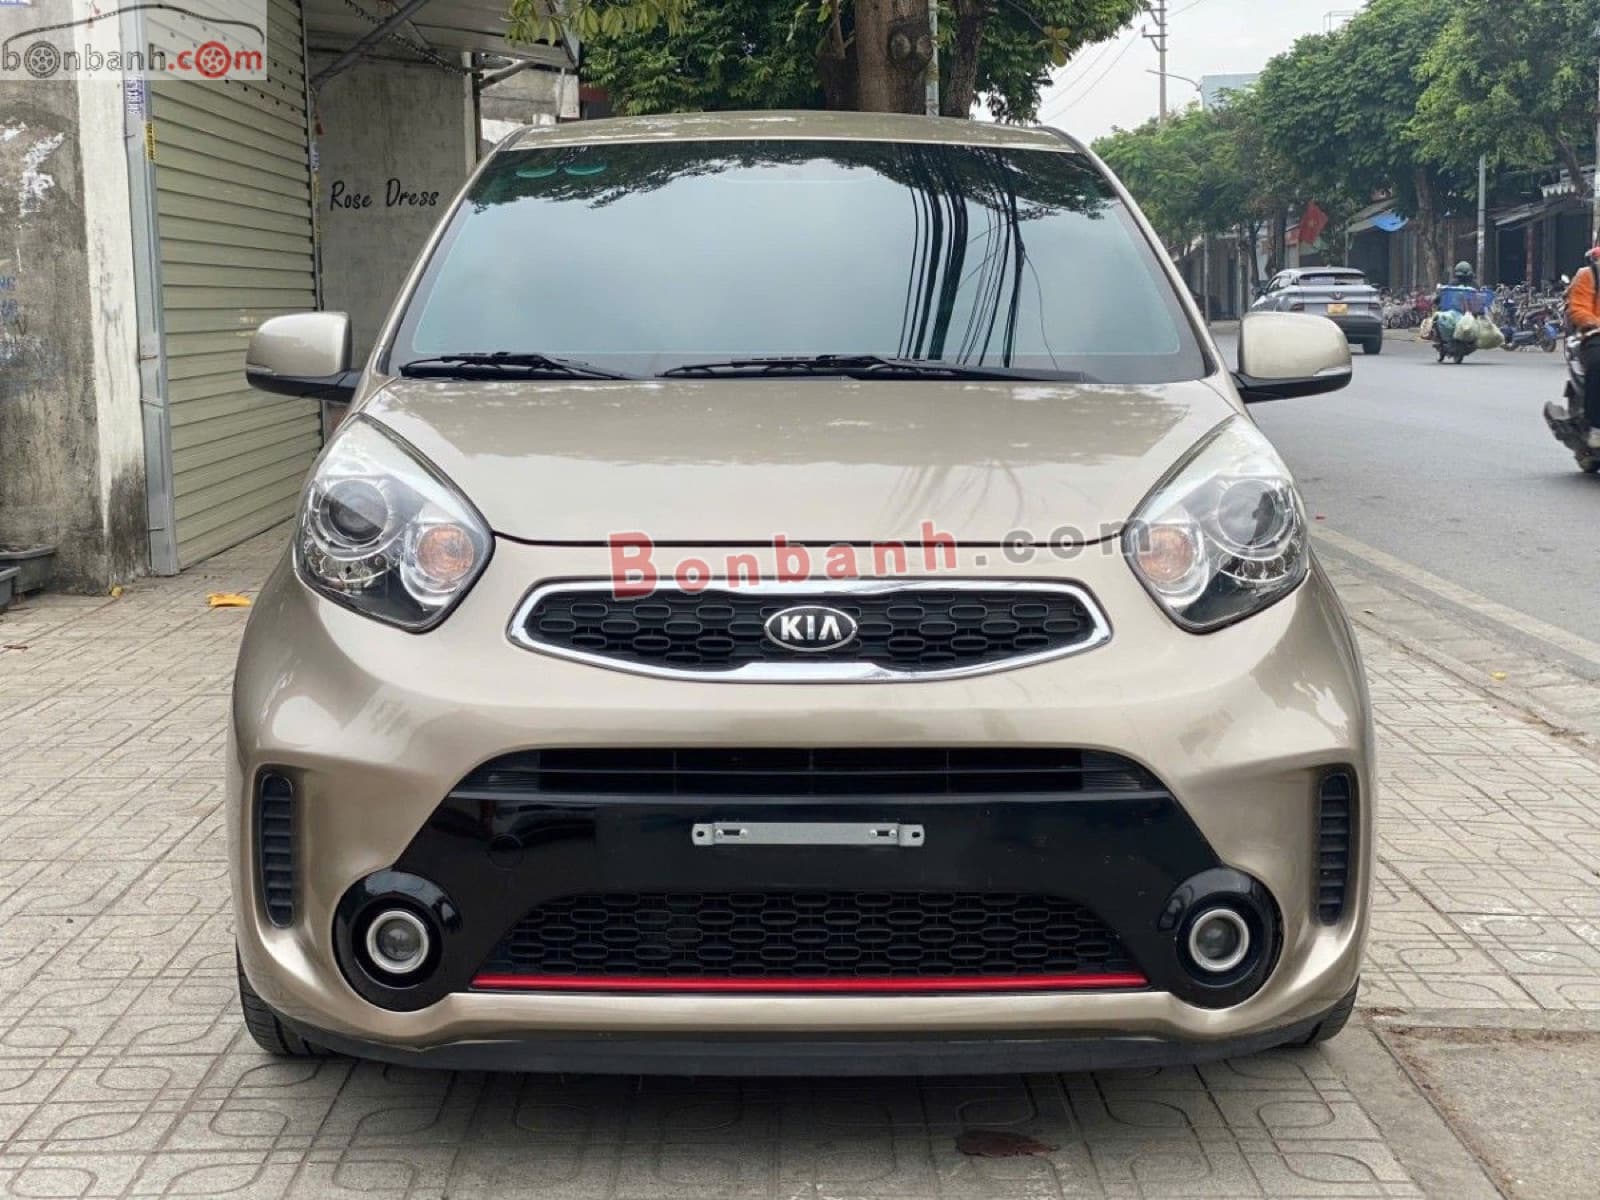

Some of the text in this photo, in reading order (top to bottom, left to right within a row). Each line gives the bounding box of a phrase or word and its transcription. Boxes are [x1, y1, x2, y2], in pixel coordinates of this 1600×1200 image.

[330, 178, 439, 211] Rose Dress
[780, 615, 842, 640] KIA
